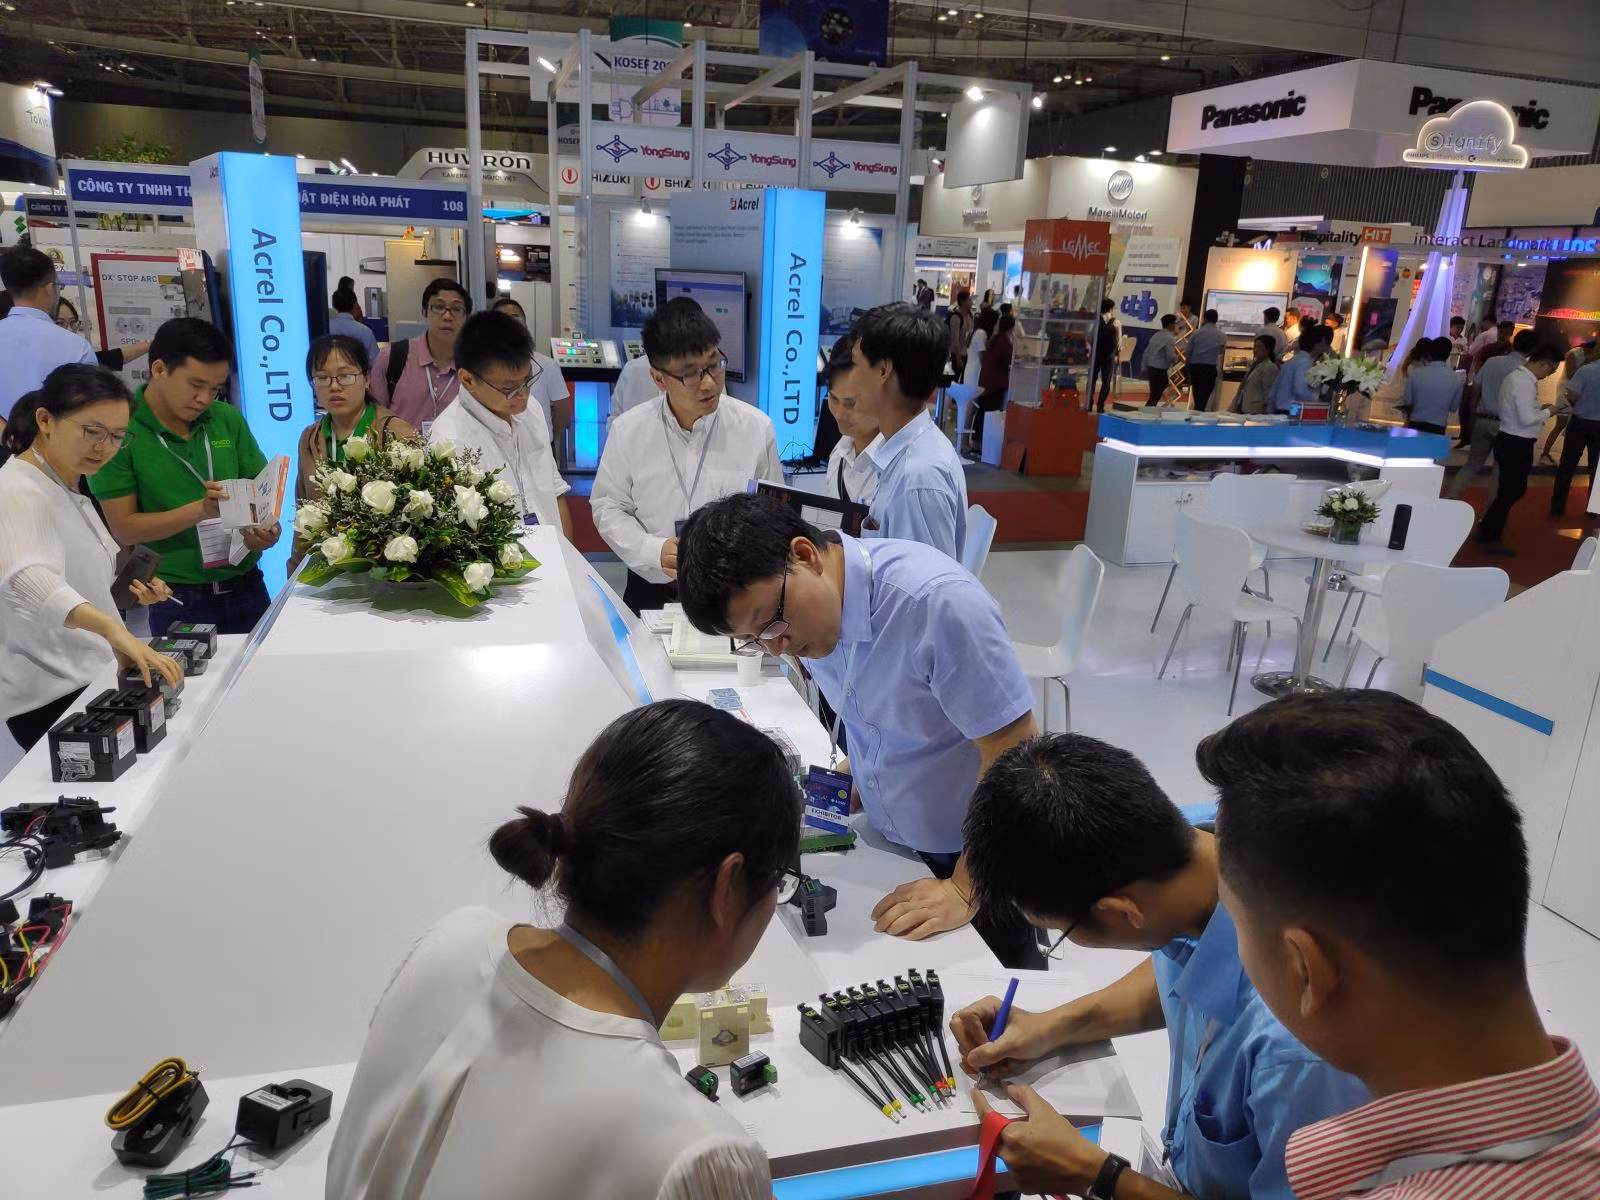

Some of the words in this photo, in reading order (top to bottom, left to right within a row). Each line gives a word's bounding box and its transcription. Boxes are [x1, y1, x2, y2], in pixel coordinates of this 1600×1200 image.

[614, 56, 649, 69] KOSEF
[1201, 89, 1307, 130] Panasonic
[1425, 132, 1504, 154] Signify
[640, 145, 690, 160] YongSung
[428, 151, 531, 170] HUVRON
[749, 153, 797, 168] YongSung
[852, 161, 898, 175] YongSung
[591, 173, 631, 185] HIZUKI
[77, 178, 114, 193] CÔNG
[116, 182, 134, 194] TY
[137, 183, 173, 196] TNHH
[320, 192, 349, 208] ĐIỆN
[352, 192, 377, 207] HÒA
[380, 194, 411, 209] PHÁT
[442, 200, 464, 212] 108
[737, 197, 760, 210] Acrel
[1087, 206, 1148, 221] MarelliMotori
[1364, 228, 1391, 241] HIT
[1413, 232, 1475, 248] interact
[1062, 234, 1101, 260] LGMEC
[251, 228, 284, 304] Acrel
[117, 274, 139, 282] STOP
[140, 274, 158, 283] ARC
[787, 252, 807, 319] Acrel
[812, 808, 842, 820] EXHIBITOR
